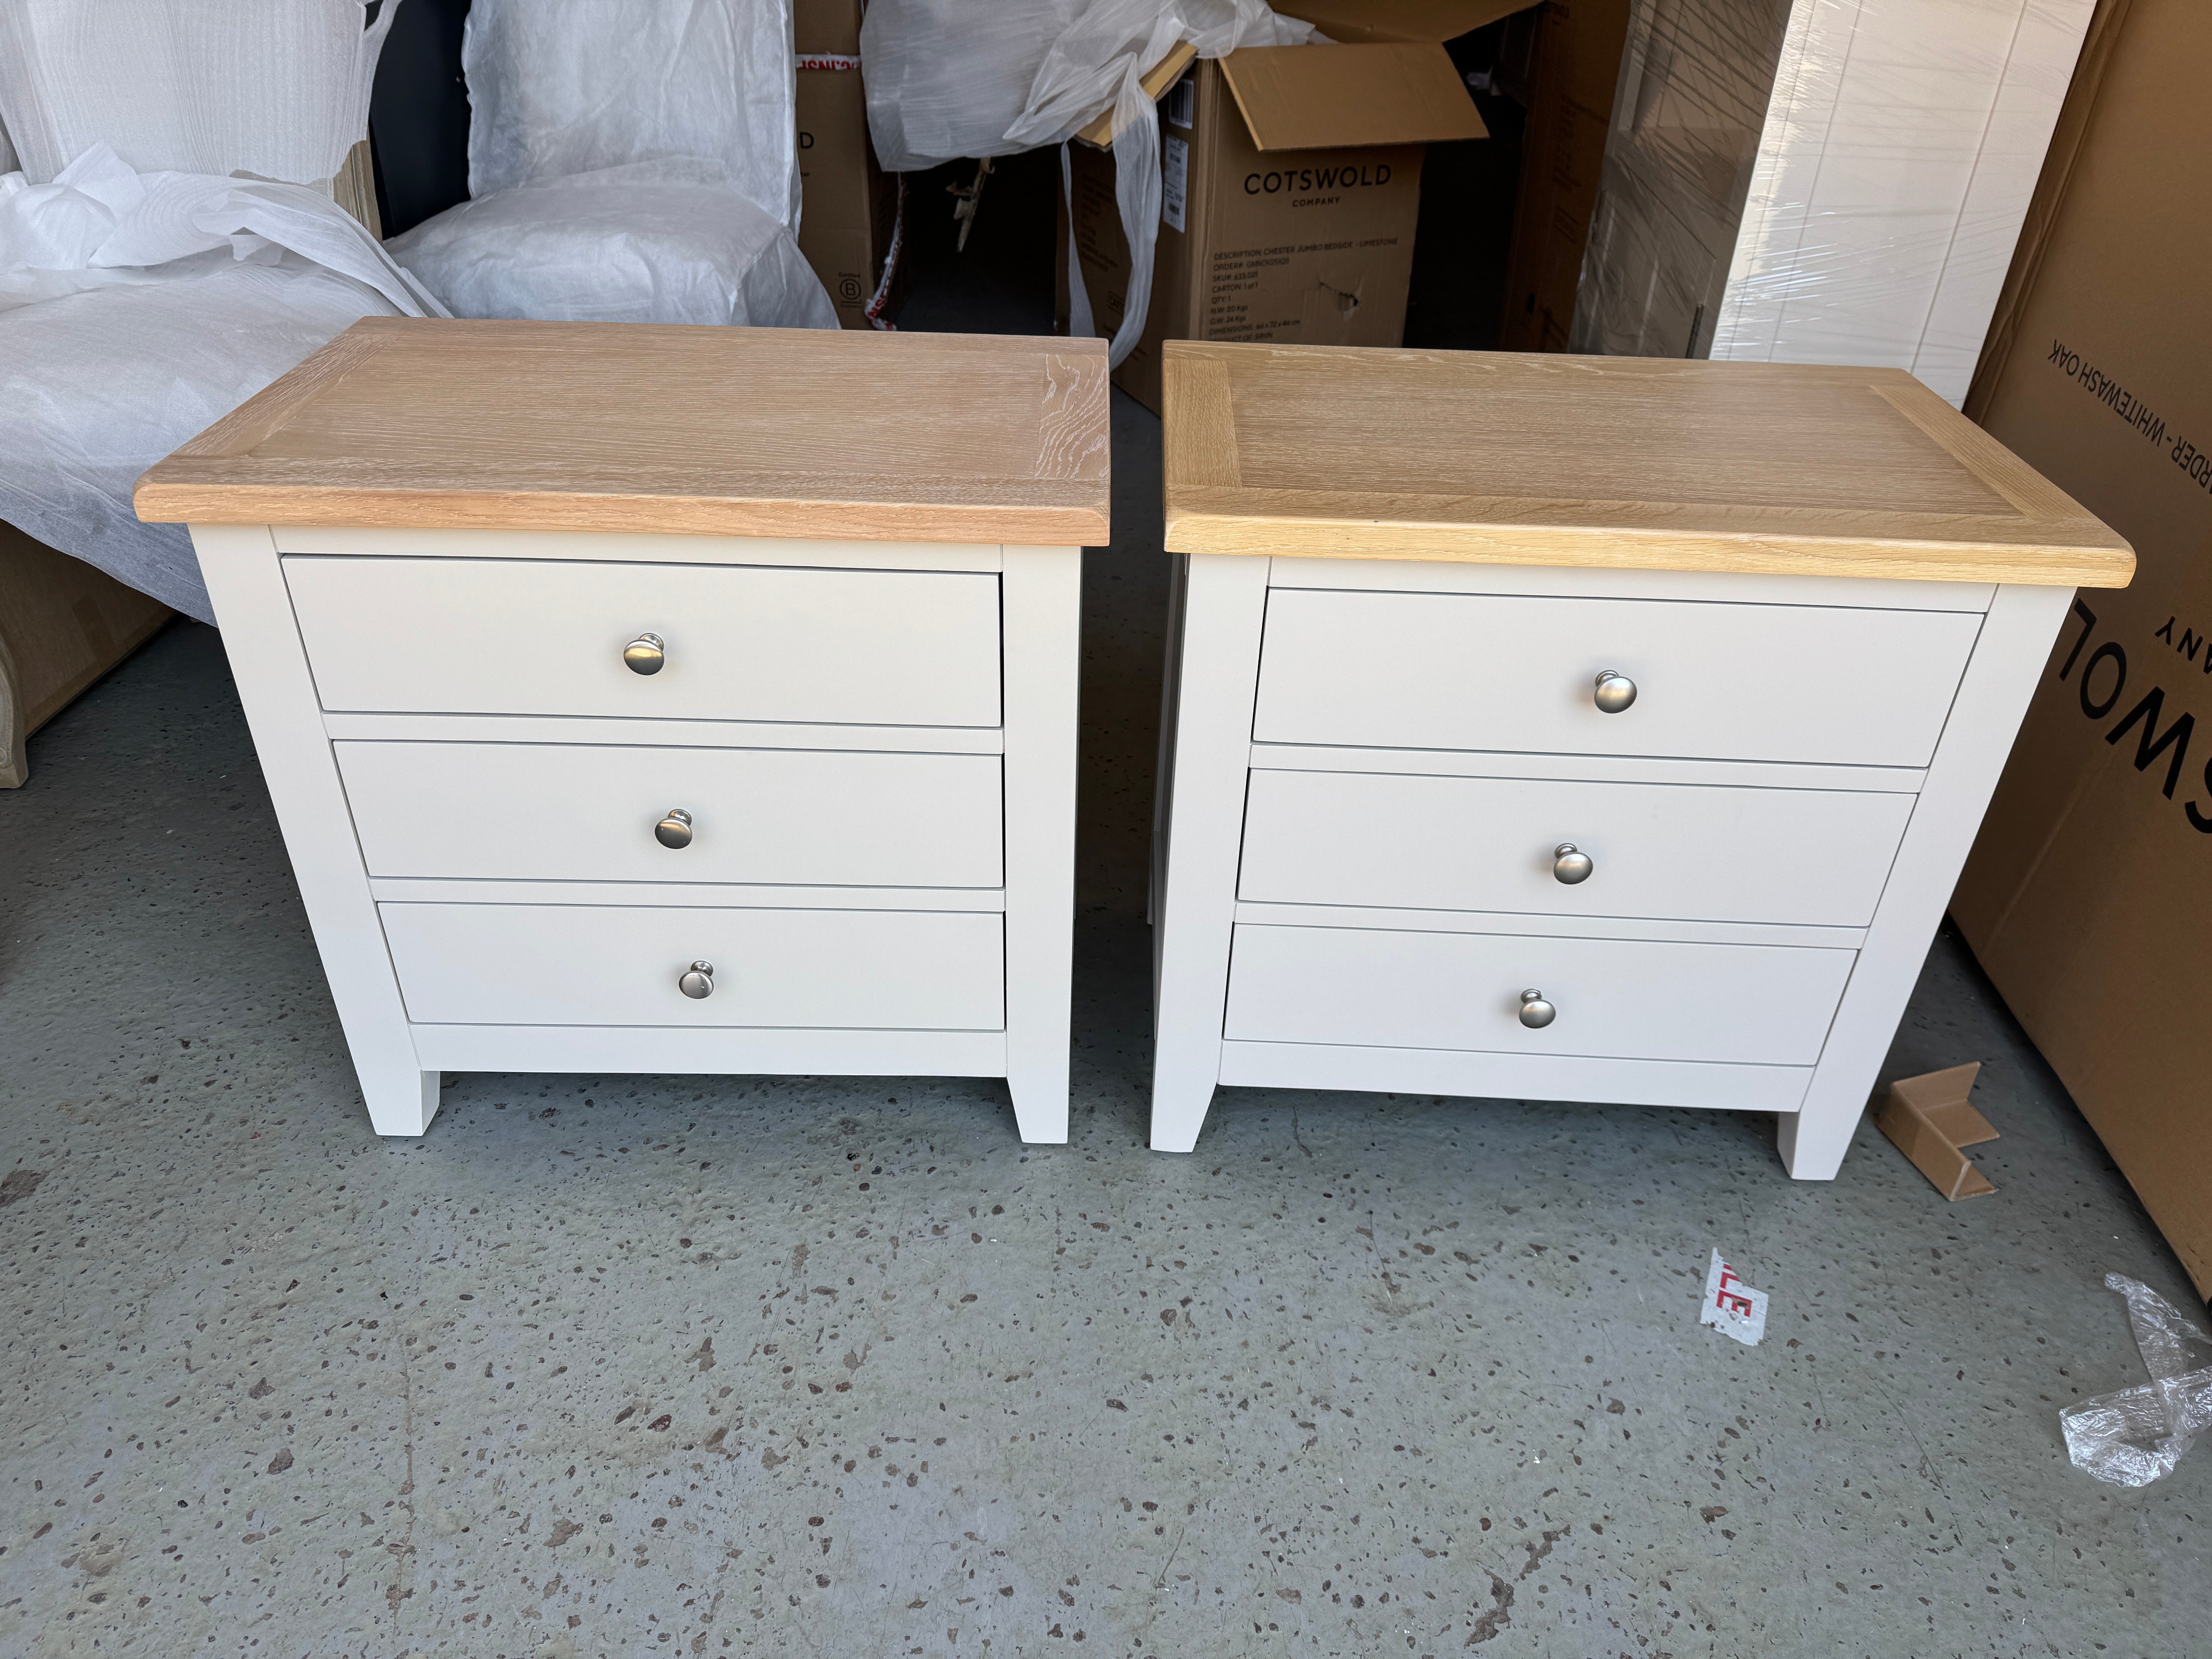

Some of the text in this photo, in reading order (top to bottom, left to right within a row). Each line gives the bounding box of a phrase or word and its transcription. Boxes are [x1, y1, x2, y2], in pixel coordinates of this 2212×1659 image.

[1244, 165, 1391, 194] COTSWOLD
[1292, 197, 1341, 207] COMPANY
[1264, 246, 1295, 255] CHESTER
[1297, 244, 1323, 252] JUMBO
[2047, 339, 2080, 376] OAK
[2078, 362, 2166, 447] WHITEWASH
[2171, 436, 2212, 495] RDER
